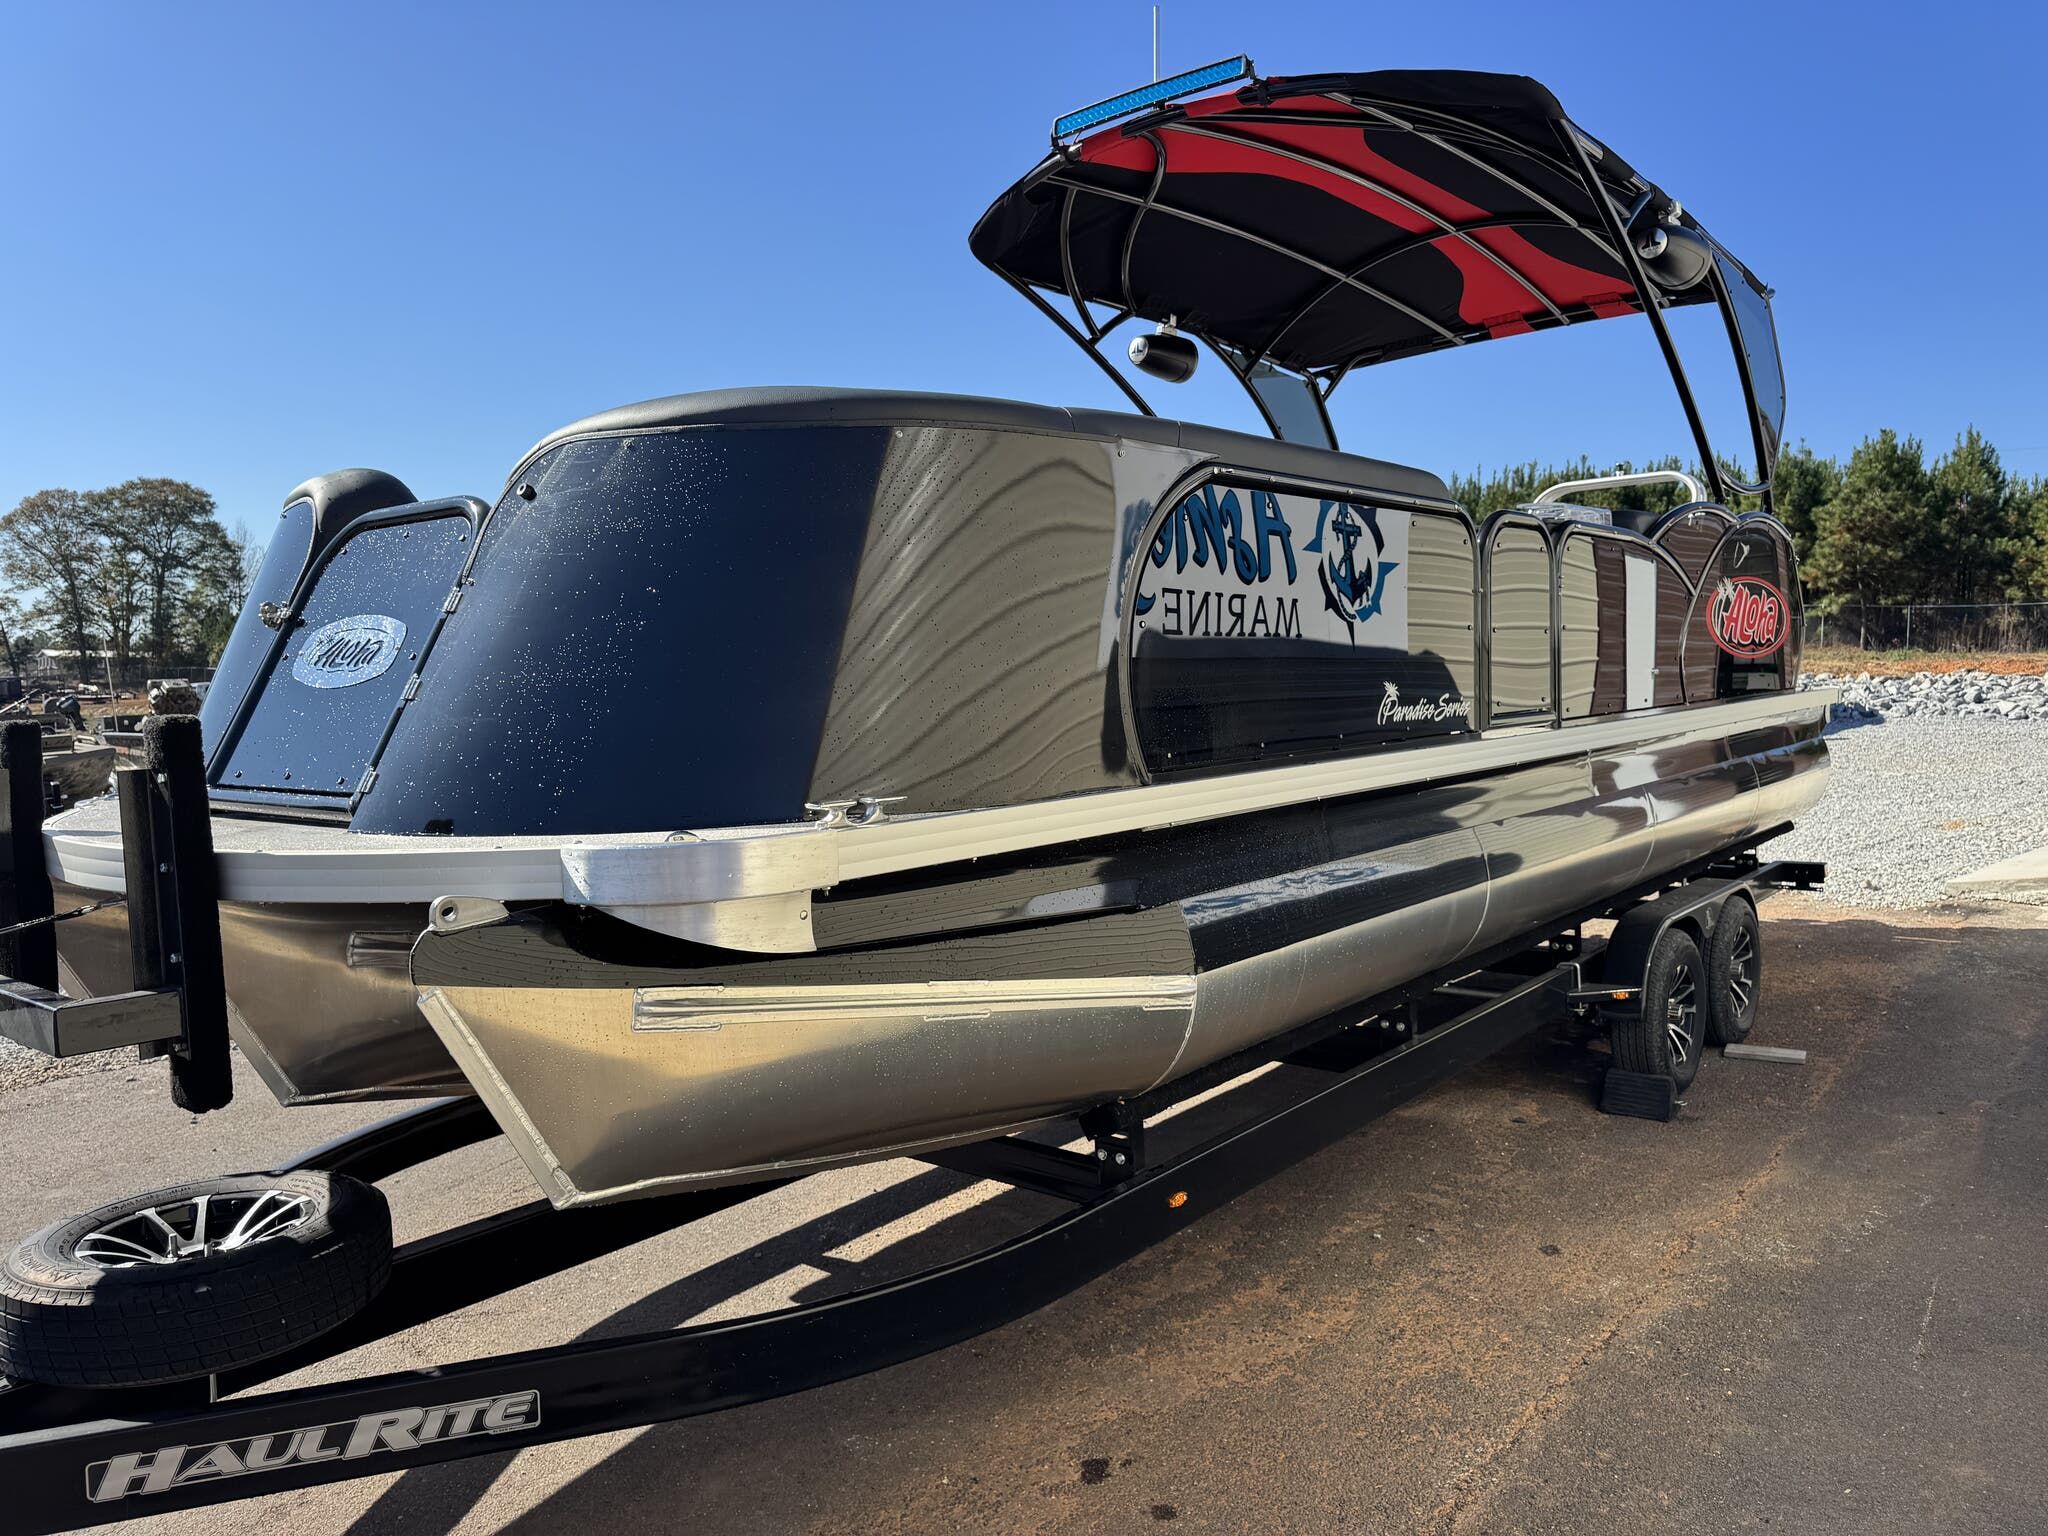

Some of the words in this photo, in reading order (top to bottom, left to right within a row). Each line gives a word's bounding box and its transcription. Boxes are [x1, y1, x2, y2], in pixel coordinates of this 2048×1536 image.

[1721, 583, 1778, 645] Aloha
[1378, 693, 1435, 725] Paradise
[1433, 692, 1471, 722] Series
